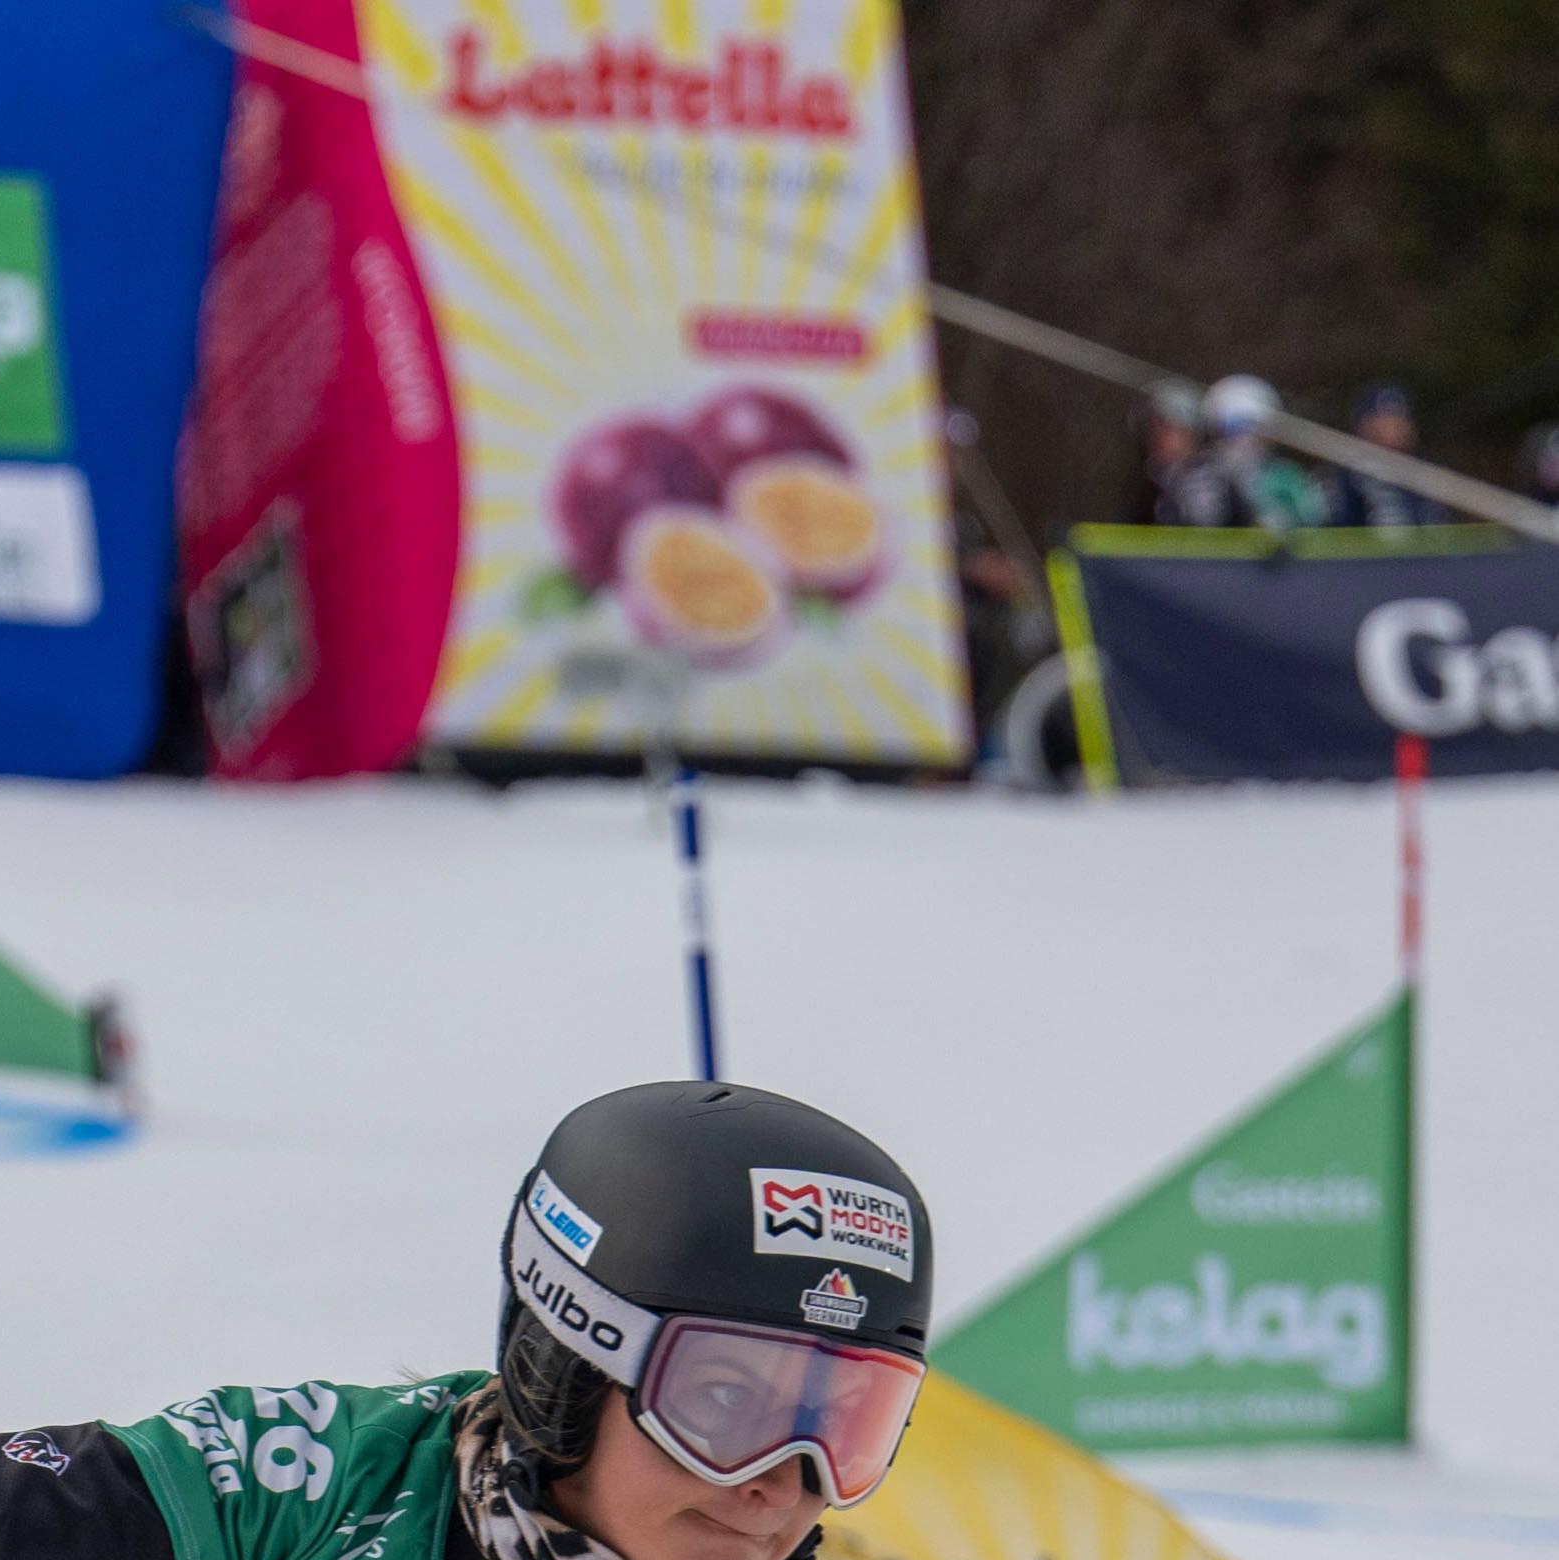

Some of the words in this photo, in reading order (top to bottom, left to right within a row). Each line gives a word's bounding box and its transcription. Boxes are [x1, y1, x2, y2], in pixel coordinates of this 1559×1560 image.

[1356, 598, 1559, 736] Ga
[827, 1187, 906, 1225] WÜRTH
[831, 1208, 909, 1242] MODYF
[517, 1258, 624, 1351] Julbo
[1067, 1252, 1389, 1391] kelag
[161, 1387, 248, 1497] ukla
